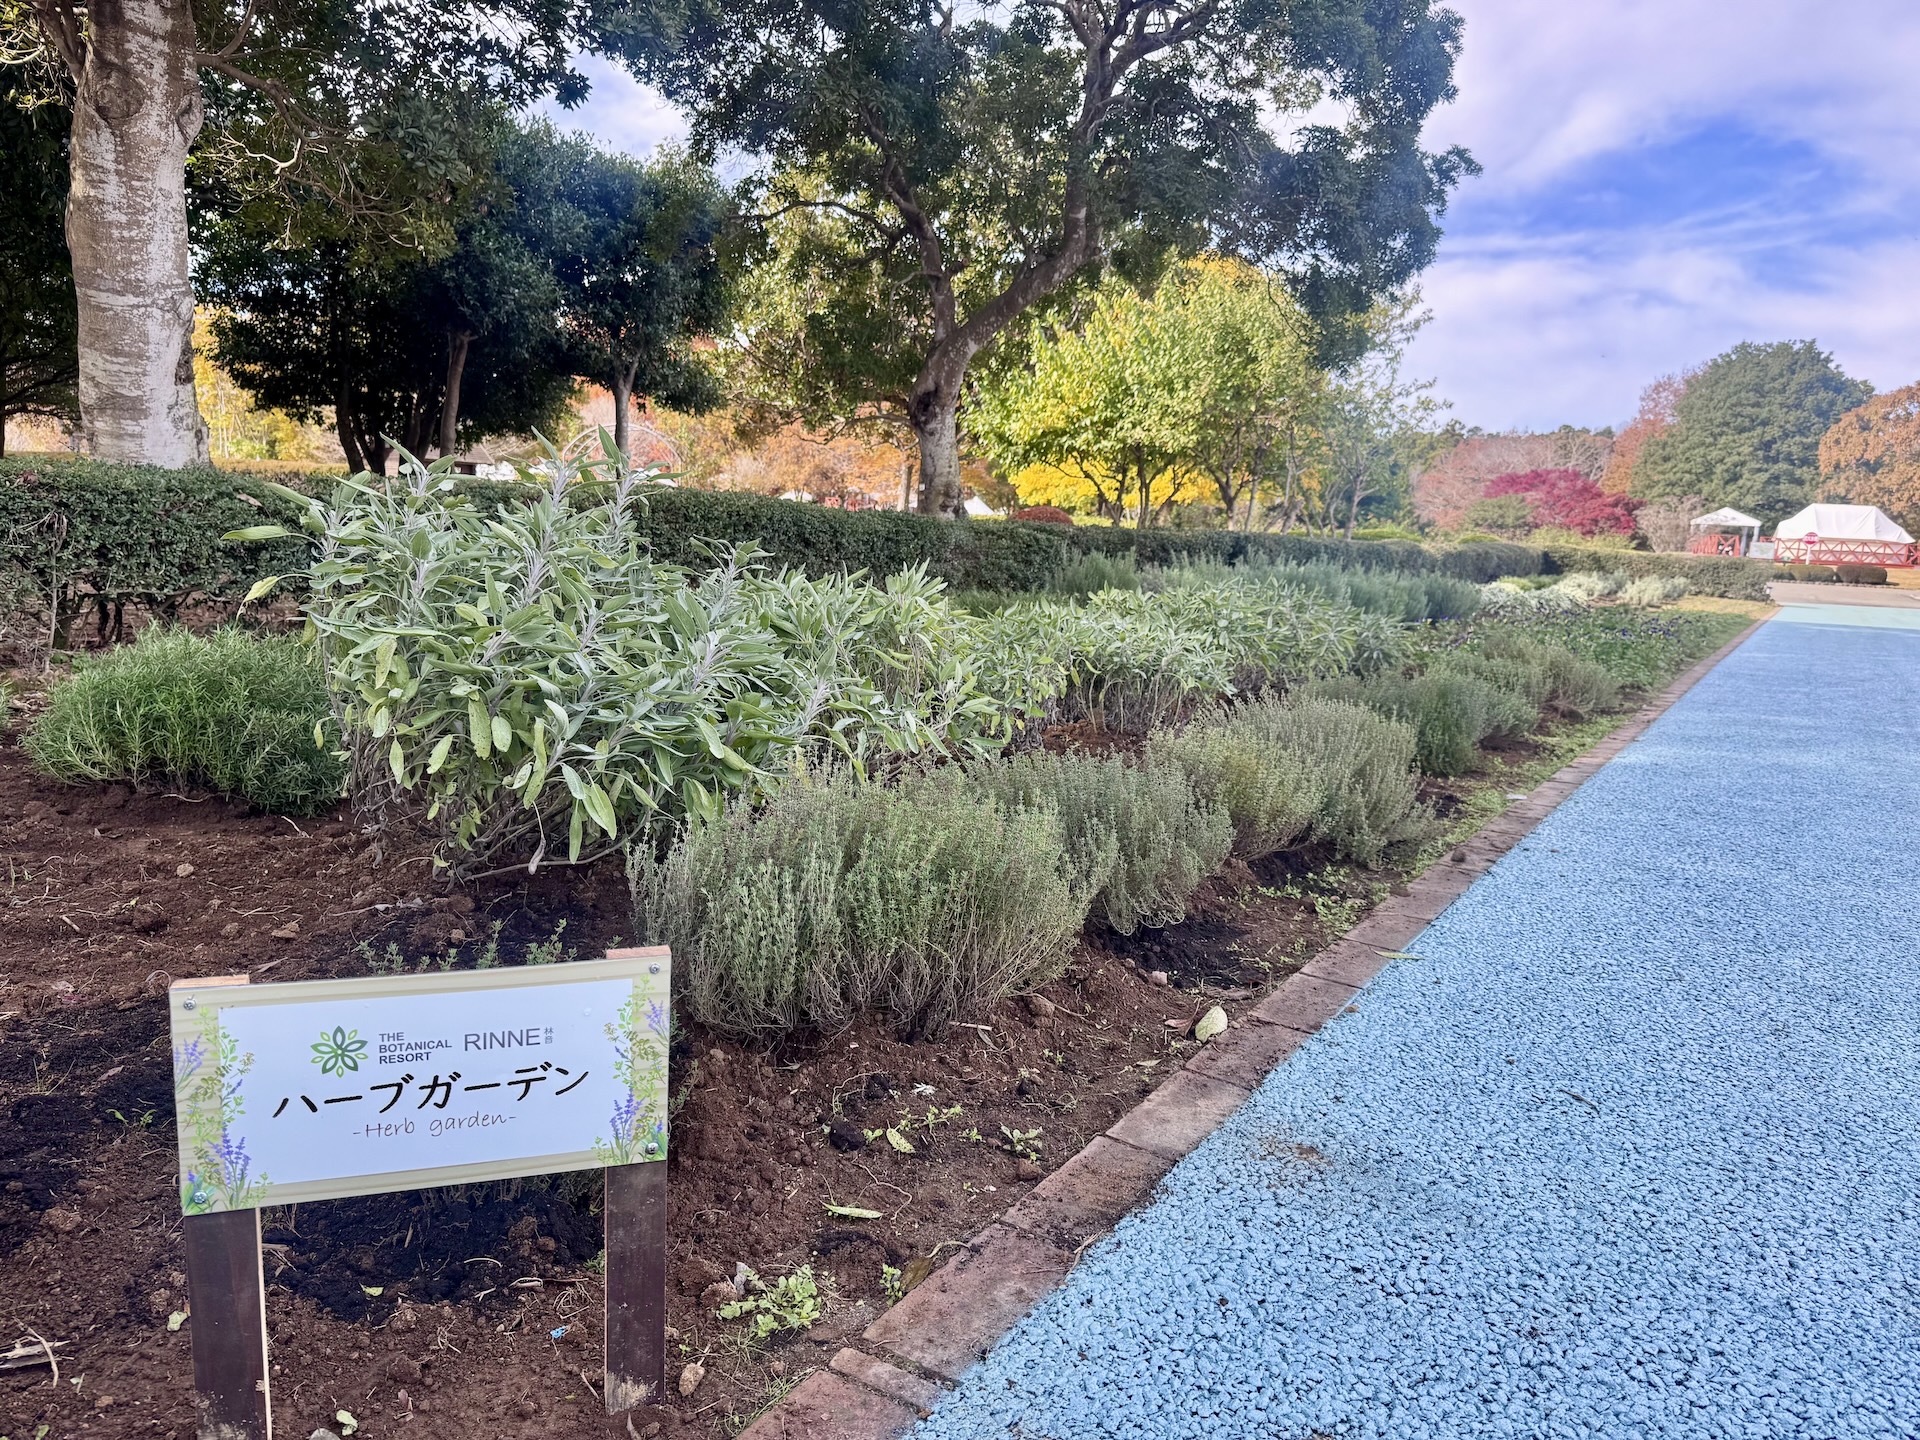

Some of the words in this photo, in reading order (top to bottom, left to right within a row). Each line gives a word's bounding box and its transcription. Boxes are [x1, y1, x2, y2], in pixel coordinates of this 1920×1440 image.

[378, 1031, 405, 1043] THE
[378, 1039, 453, 1054] BOTANICAL
[463, 1027, 541, 1052] RINNE
[378, 1051, 432, 1065] RESORT
[272, 1061, 589, 1118] ハーブガーデン
[352, 1117, 415, 1138] -Herb
[429, 1110, 517, 1137] garden-
